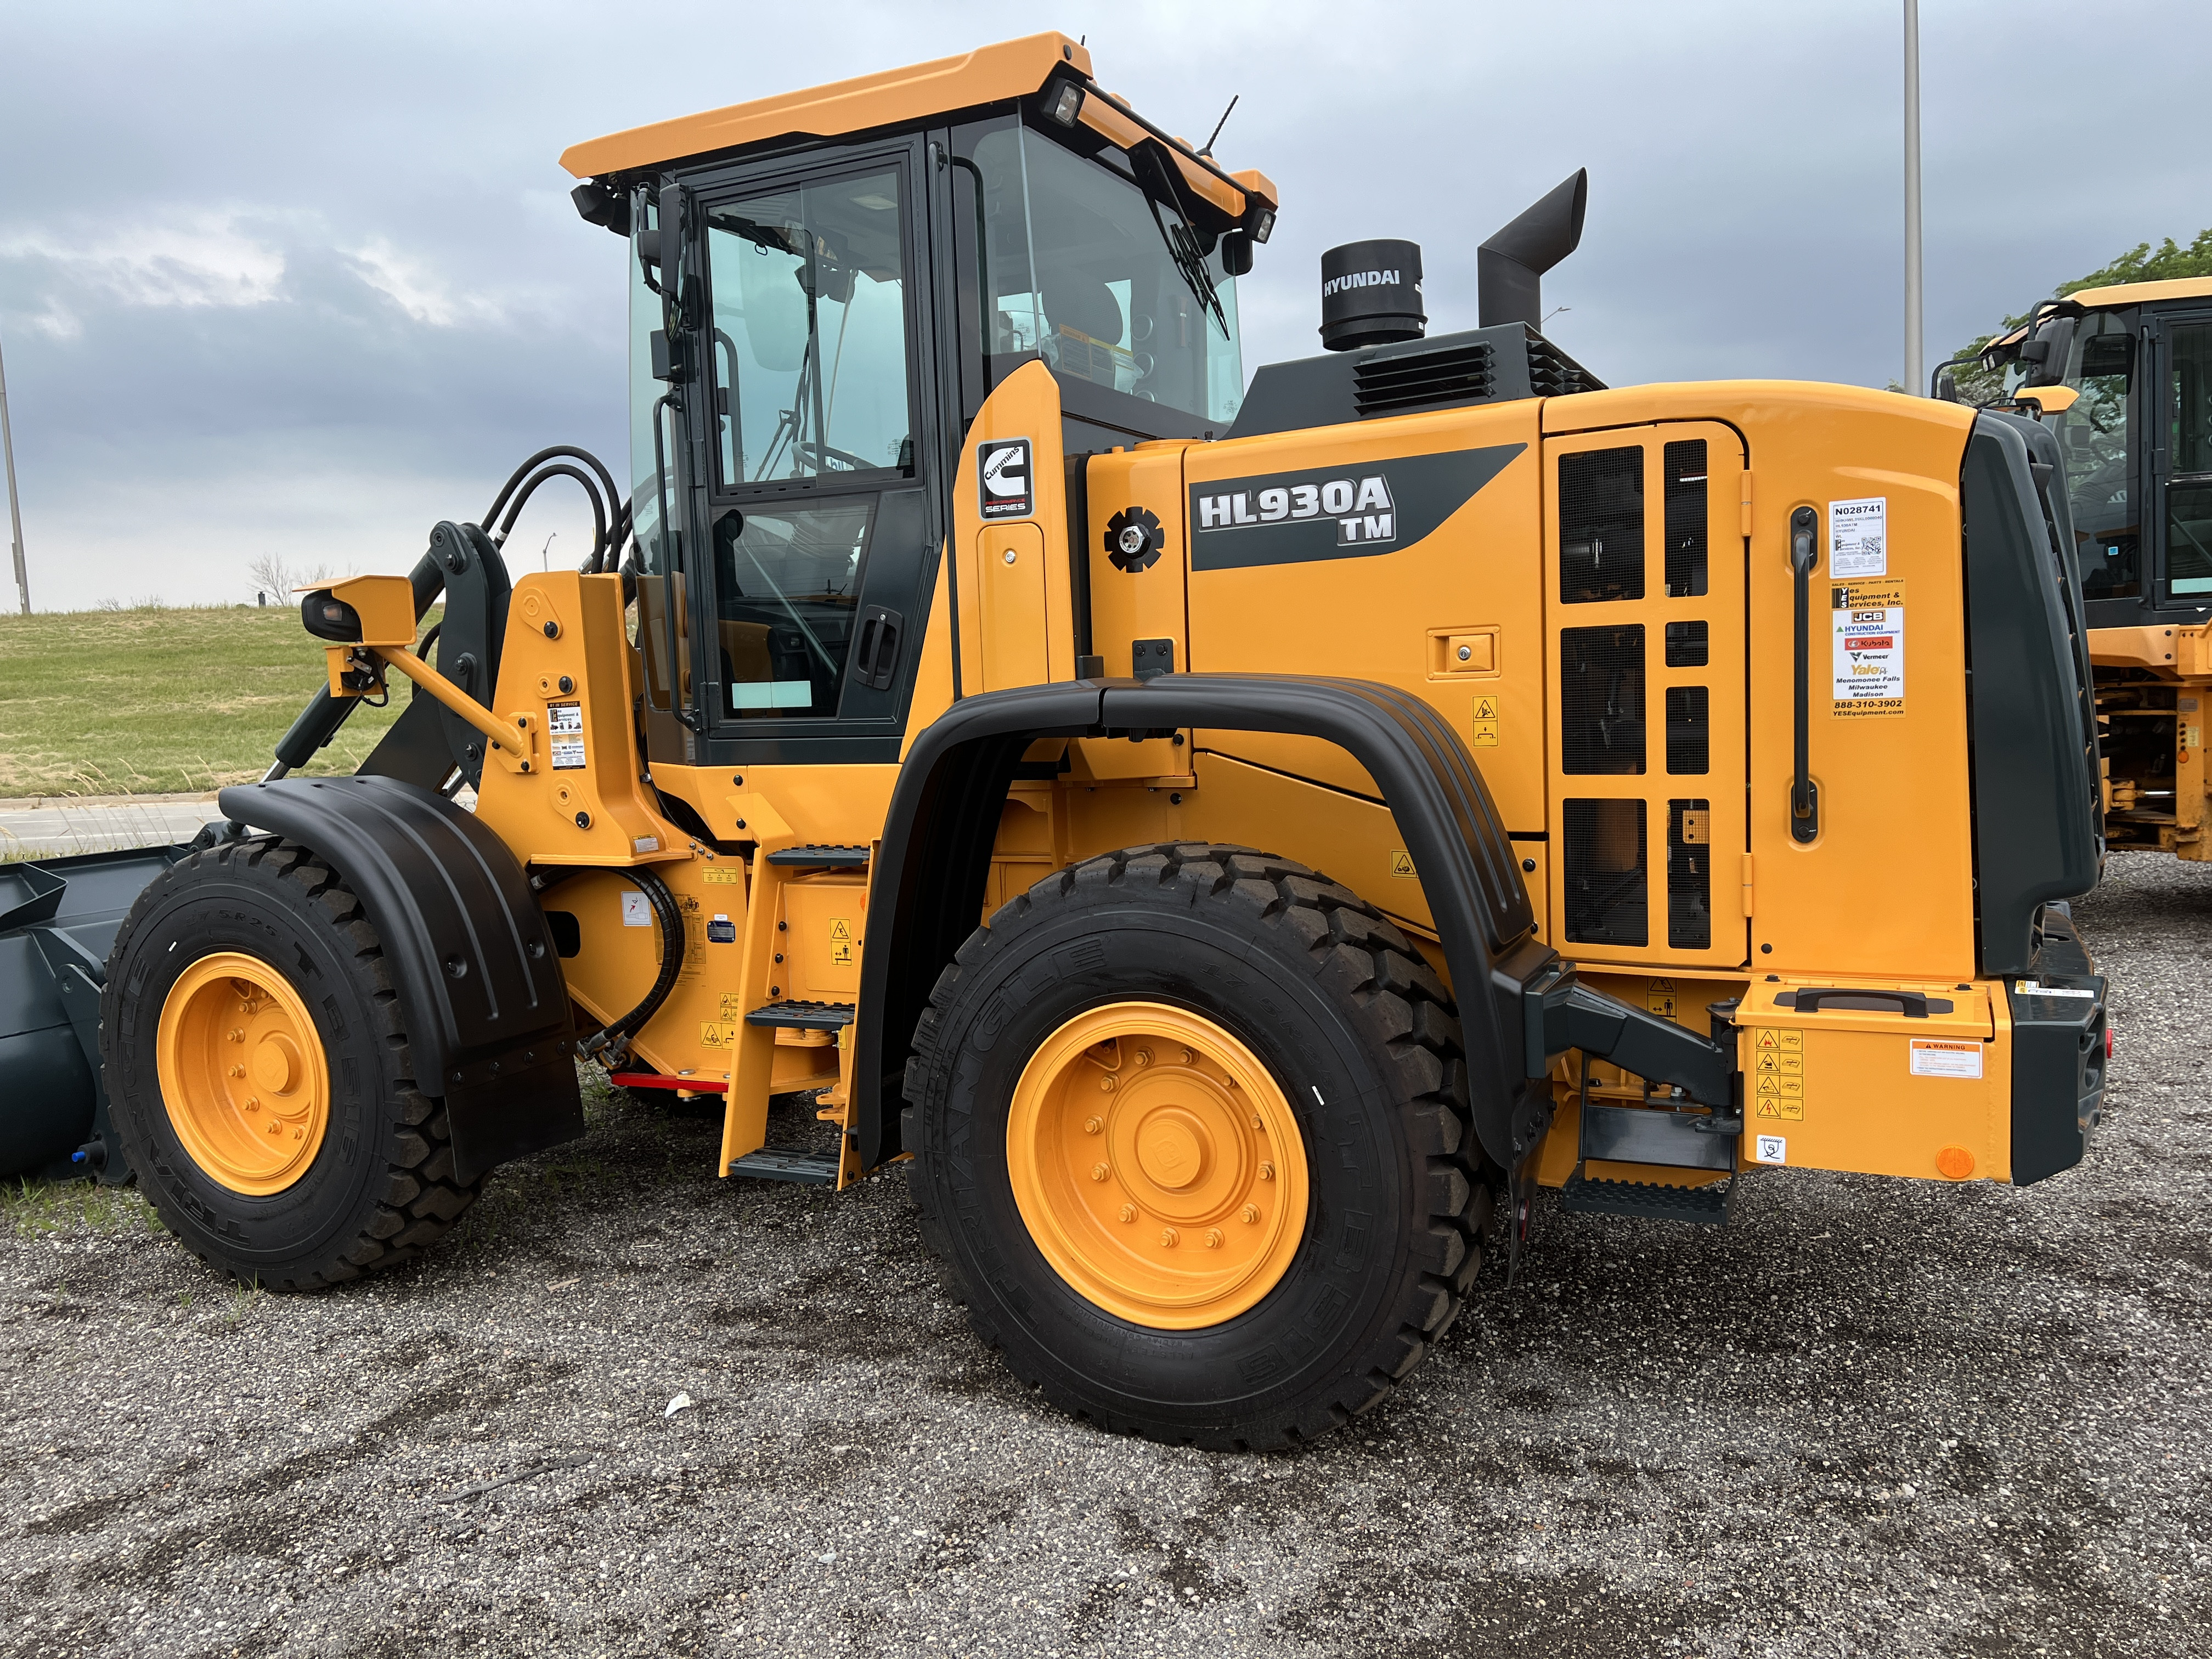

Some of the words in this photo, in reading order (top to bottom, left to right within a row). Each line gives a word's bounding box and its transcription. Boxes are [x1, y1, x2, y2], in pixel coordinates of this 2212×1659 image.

[1324, 269, 1400, 297] HYUNDAI
[984, 447, 1020, 480] Cummins
[985, 503, 1026, 512] SERIES
[1200, 476, 1391, 528] HL930A
[1835, 505, 1881, 515] N028741
[1340, 514, 1392, 541] TM
[1854, 612, 1883, 622] JCB
[1851, 664, 1880, 675] Yale
[1834, 700, 1902, 709] 888-310-3902
[119, 953, 252, 1247] TRIANGLE
[949, 937, 1106, 1332] TRIANGLE
